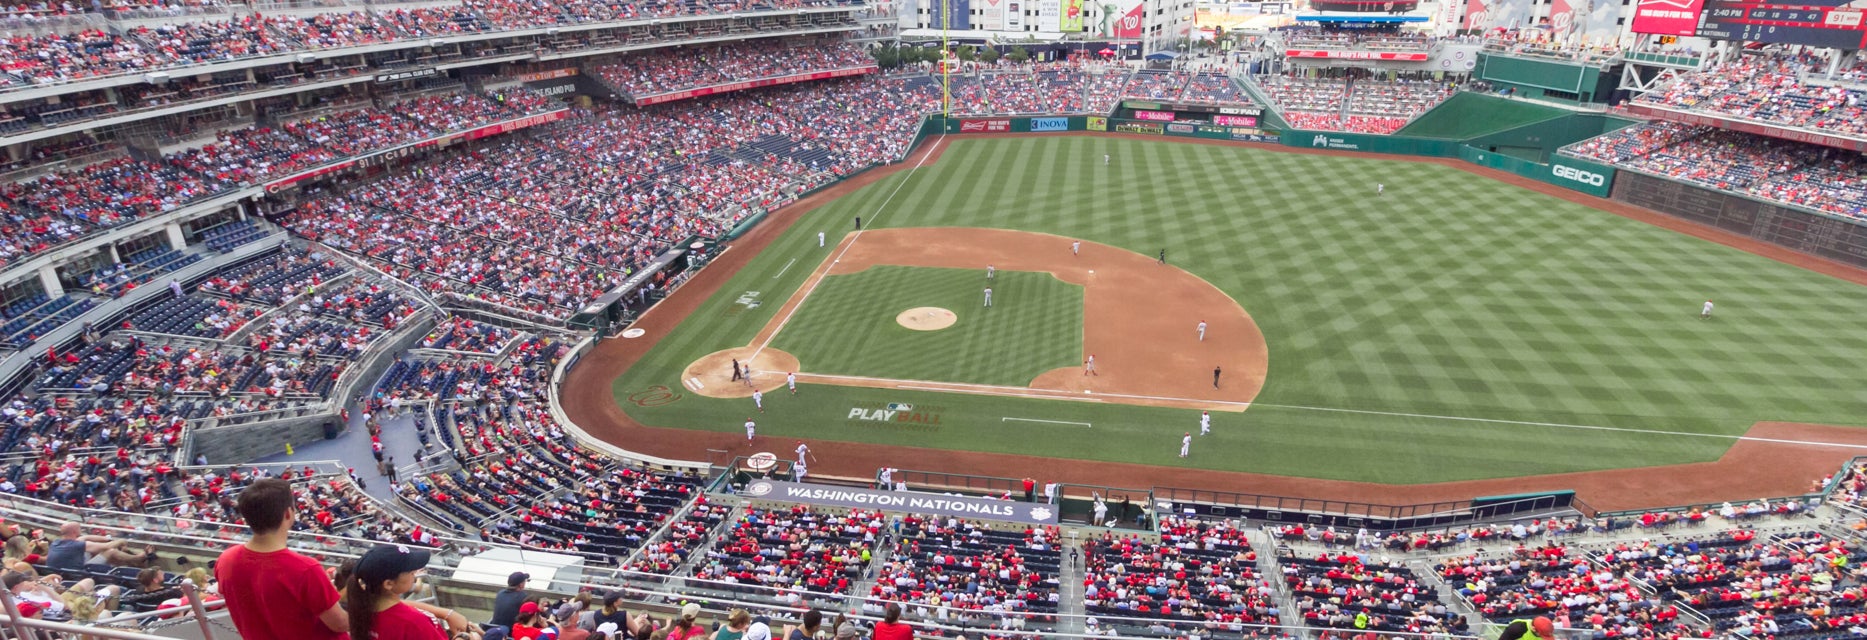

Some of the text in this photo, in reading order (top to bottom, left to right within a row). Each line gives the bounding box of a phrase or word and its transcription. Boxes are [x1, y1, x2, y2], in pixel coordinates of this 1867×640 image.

[1833, 14, 1844, 22] 91
[544, 85, 564, 96] ISLAND
[564, 83, 576, 93] PUB
[501, 121, 516, 131] THIS
[534, 114, 546, 125] FOR
[1040, 119, 1067, 128] INOVA
[1764, 128, 1780, 136] THIS
[1781, 130, 1807, 141] BUD'S
[1807, 134, 1824, 144] FOR
[1552, 164, 1604, 187] GEICO
[848, 407, 896, 421] PLAY
[787, 486, 905, 506] WASHINGTON
[909, 498, 1014, 516] NATIONALS
